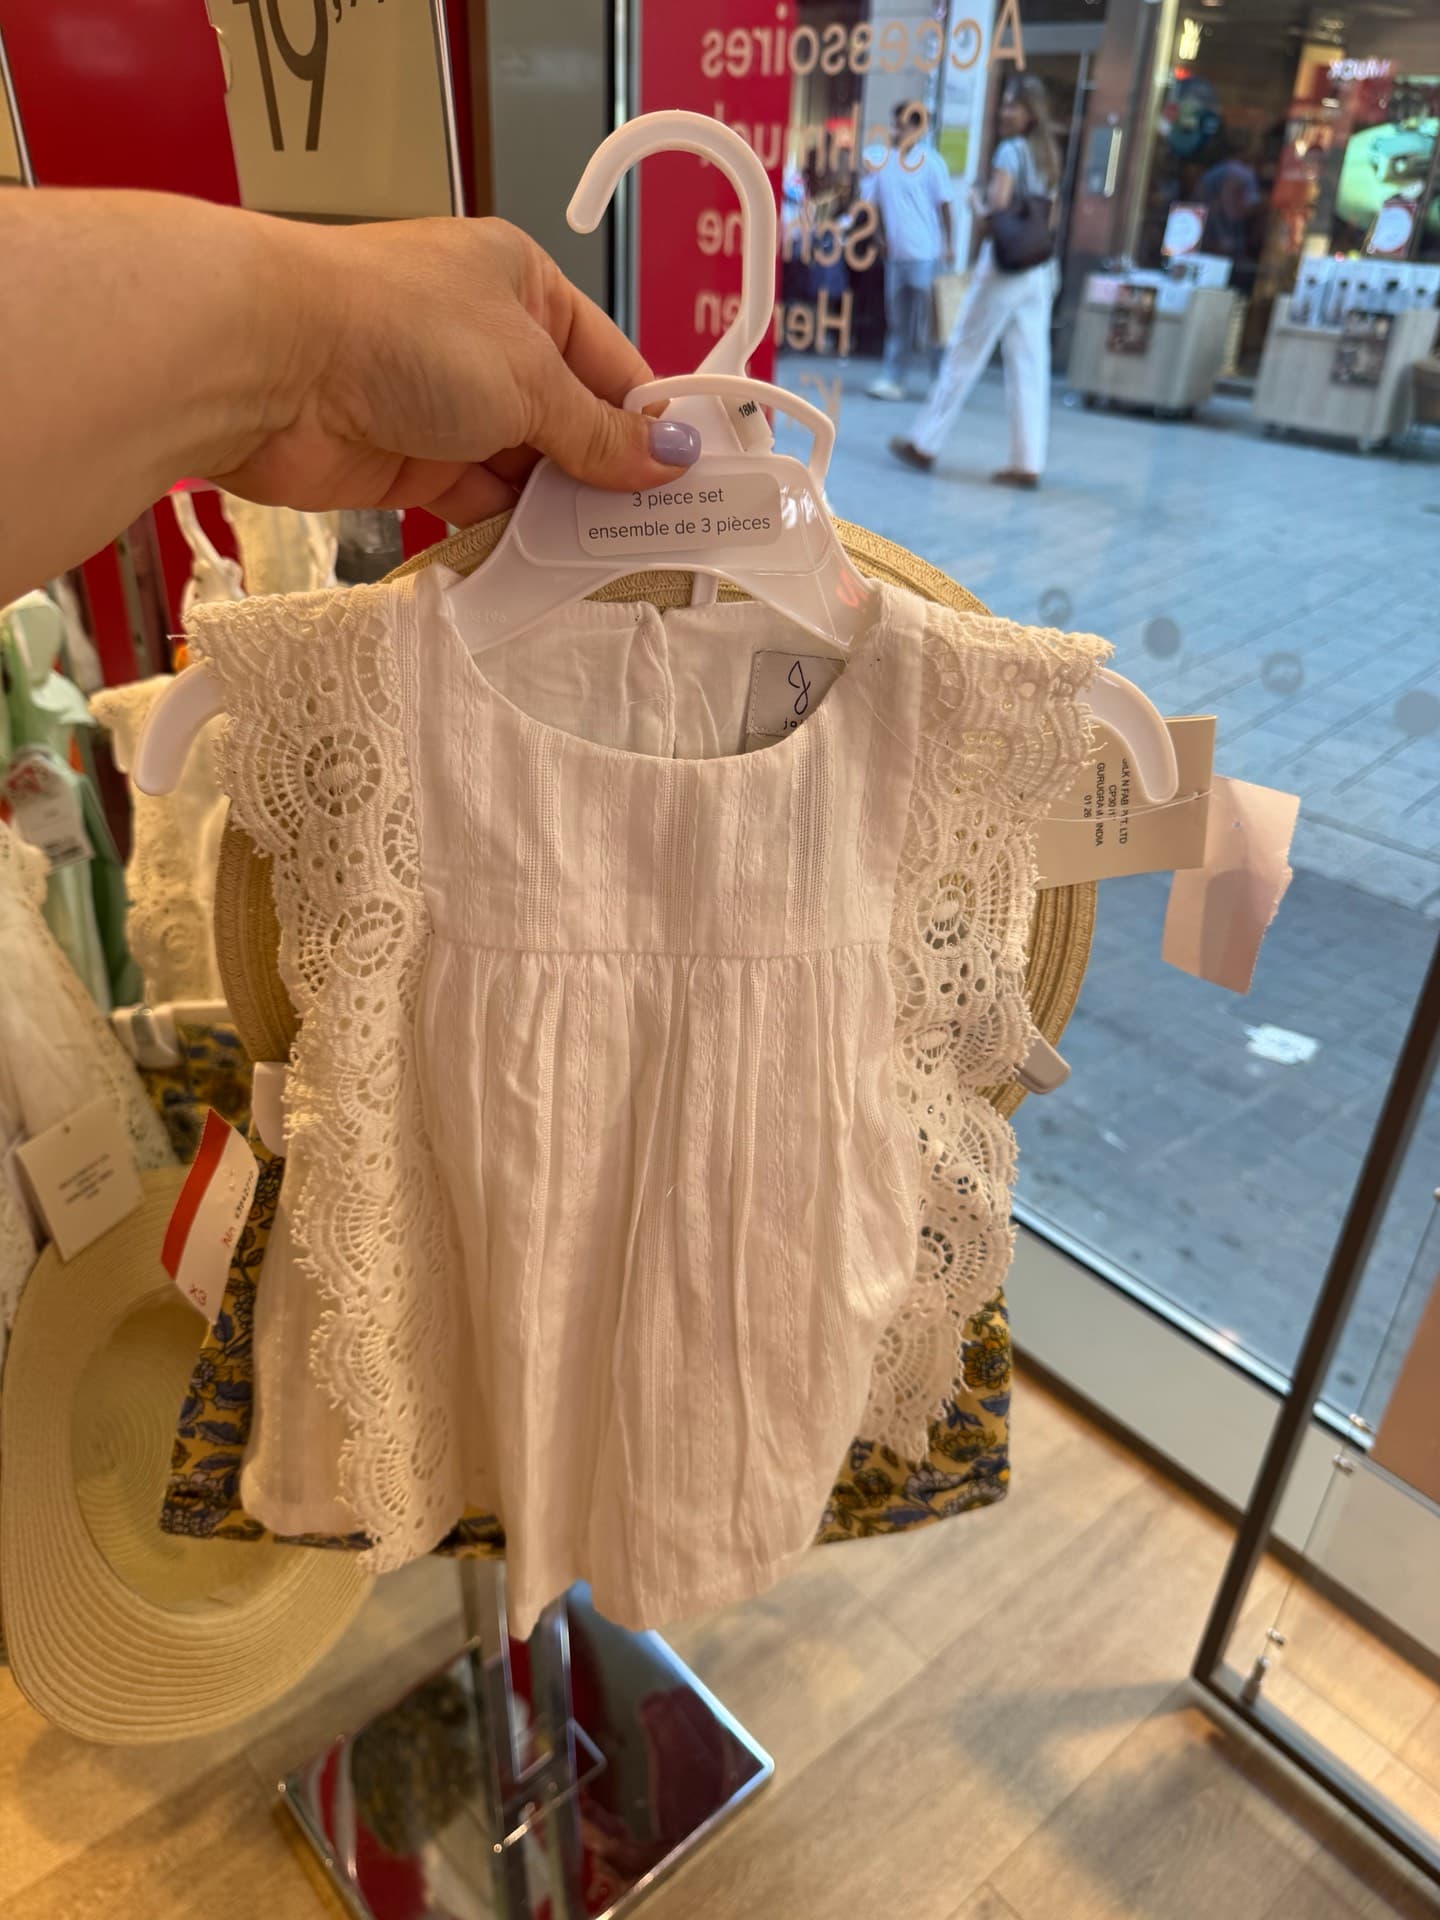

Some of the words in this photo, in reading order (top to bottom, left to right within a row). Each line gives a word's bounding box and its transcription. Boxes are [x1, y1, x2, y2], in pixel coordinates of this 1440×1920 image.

[738, 399, 758, 419] 18M
[632, 491, 642, 507] 3
[648, 489, 694, 510] piece
[699, 488, 725, 503] set
[588, 519, 669, 540] ensemble
[674, 518, 696, 535] de
[702, 518, 712, 534] 3
[717, 515, 771, 536] pièces
[1095, 822, 1104, 847] INDIA
